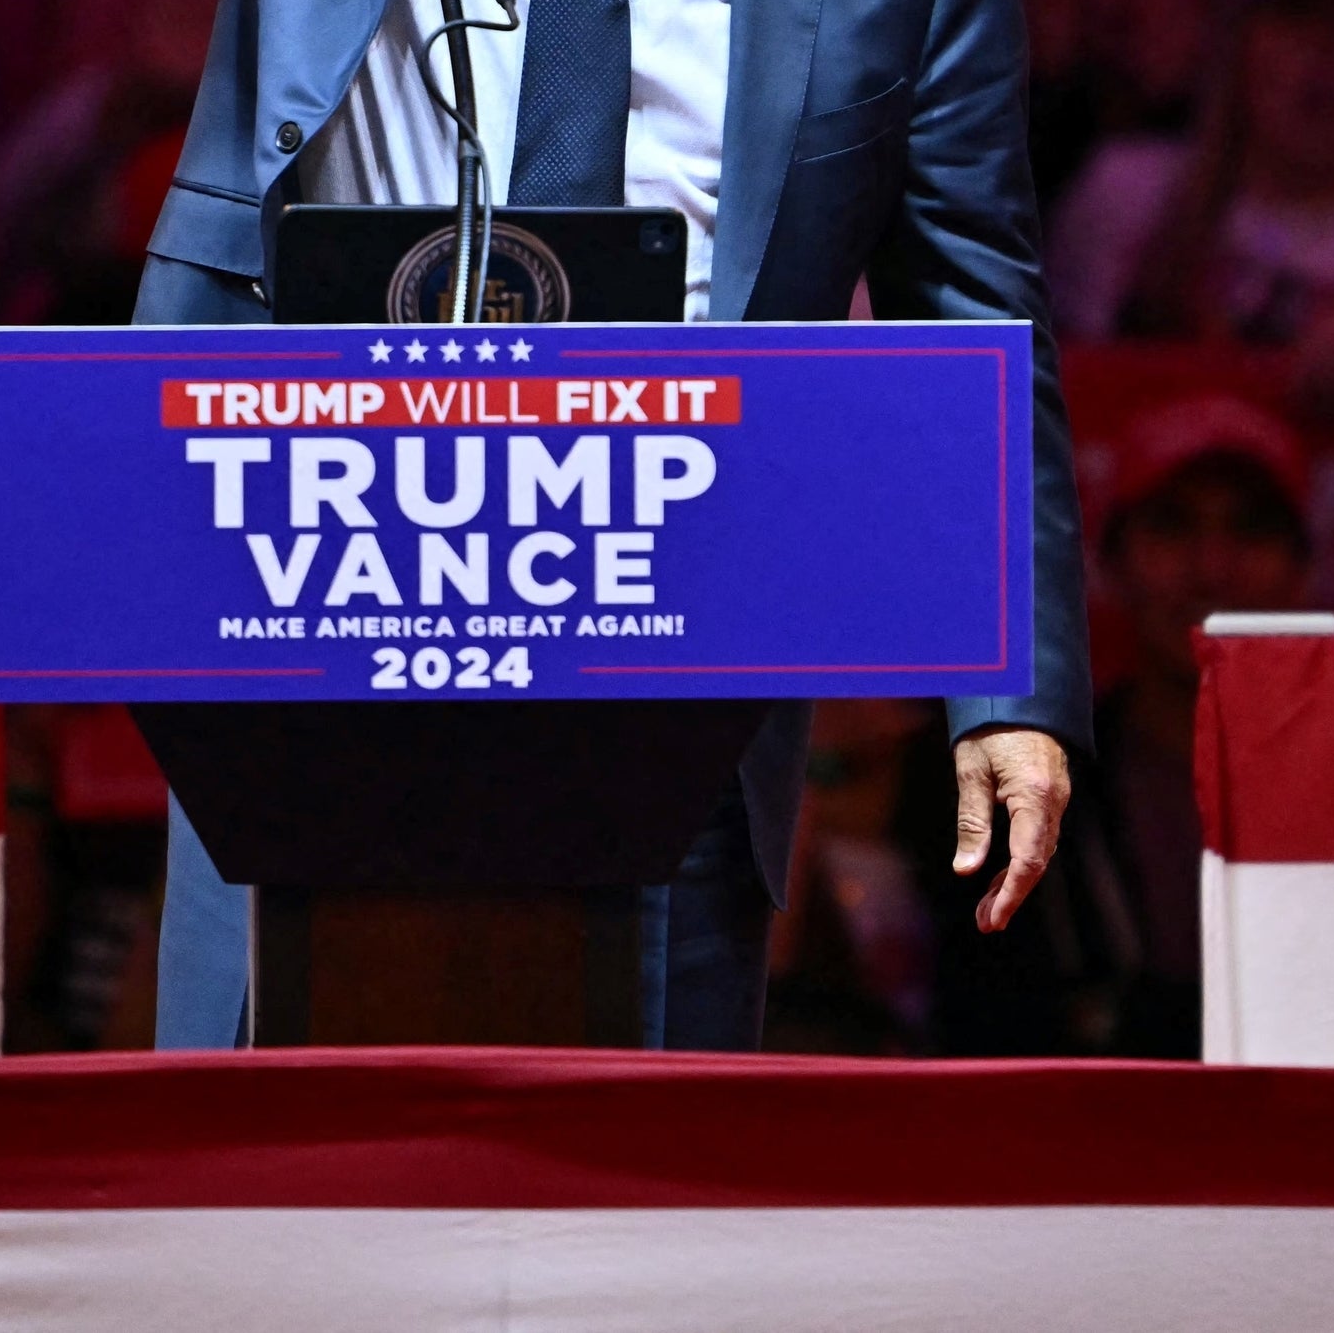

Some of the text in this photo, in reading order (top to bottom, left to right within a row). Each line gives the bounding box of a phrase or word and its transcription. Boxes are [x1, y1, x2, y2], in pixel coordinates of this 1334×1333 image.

[185, 380, 717, 426] TRUMP WILL FIX IT
[185, 434, 717, 529] TRUMP
[246, 531, 655, 607] VANCE
[219, 614, 685, 639] MAKE AMERICA GREAT AGAIN!
[371, 646, 533, 690] 2024
